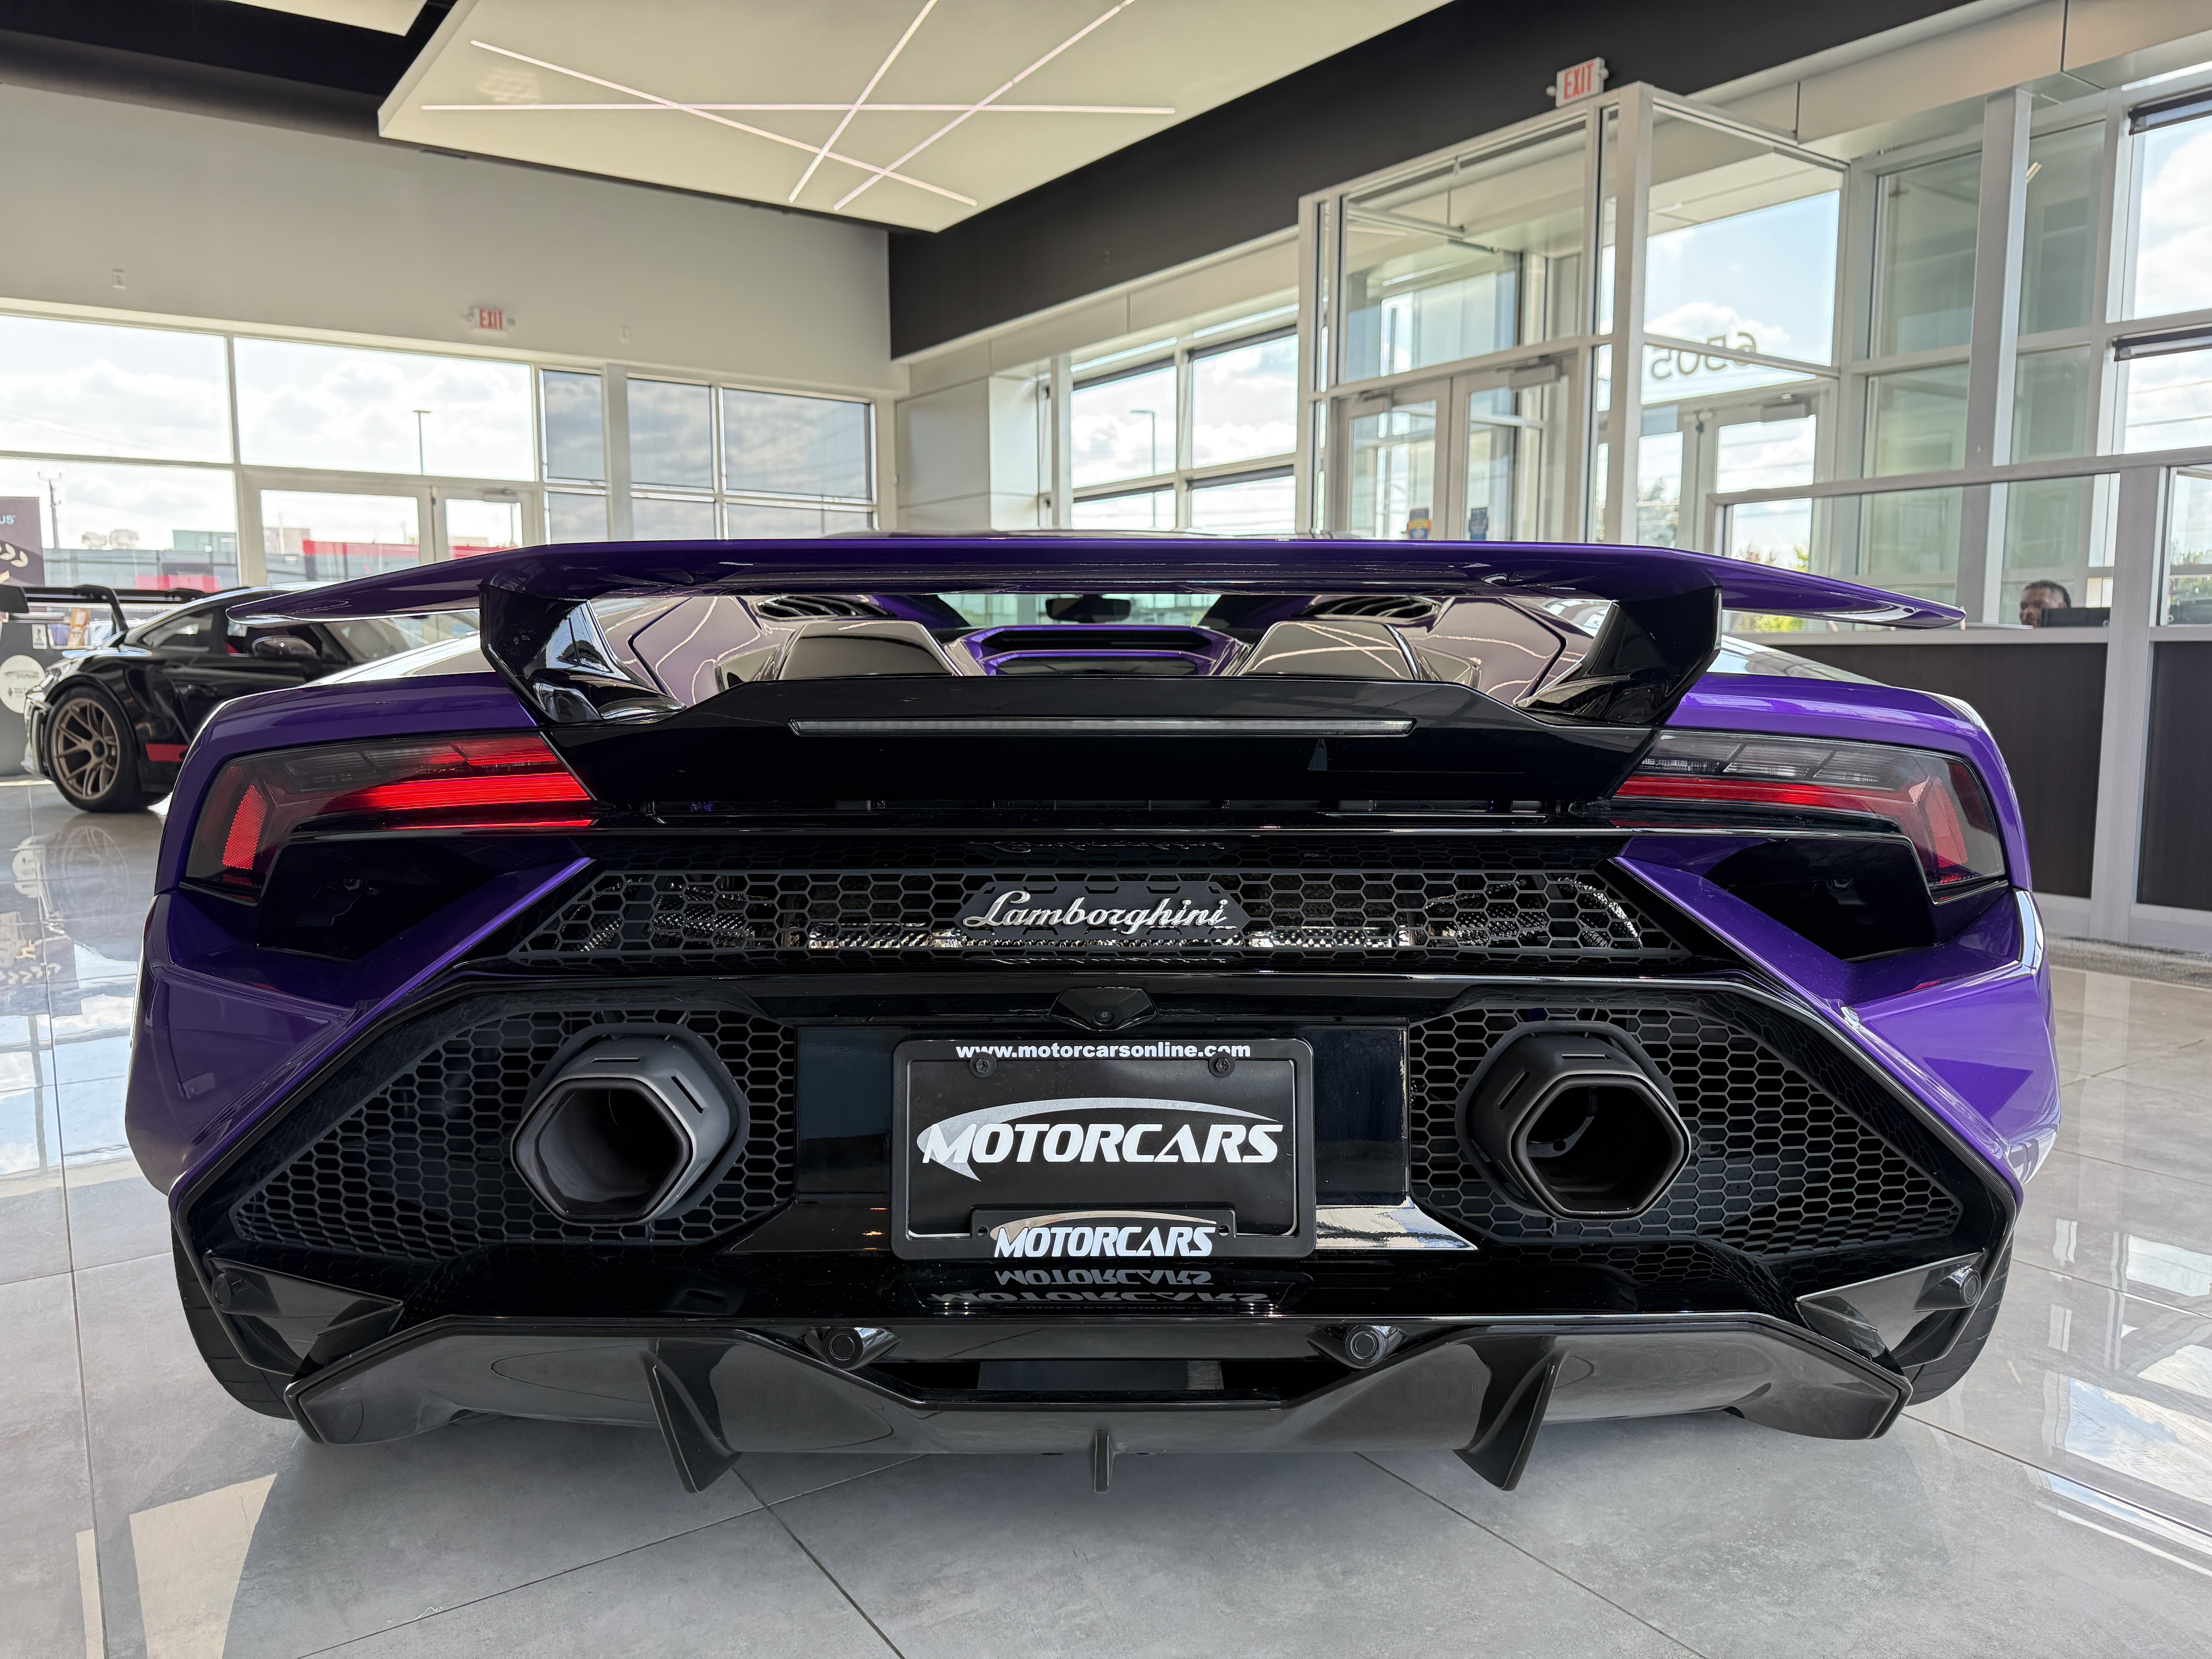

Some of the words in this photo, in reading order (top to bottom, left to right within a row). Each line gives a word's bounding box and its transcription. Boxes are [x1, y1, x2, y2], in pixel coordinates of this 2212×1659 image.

[1564, 62, 1594, 100] EXIT
[479, 309, 503, 329] EXIT
[963, 891, 1227, 935] Lamborghini
[956, 1042, 1251, 1058] www.motorcarsonline.com
[922, 1123, 1283, 1163] MOTORCARS
[994, 1226, 1216, 1258] MOTORCARS
